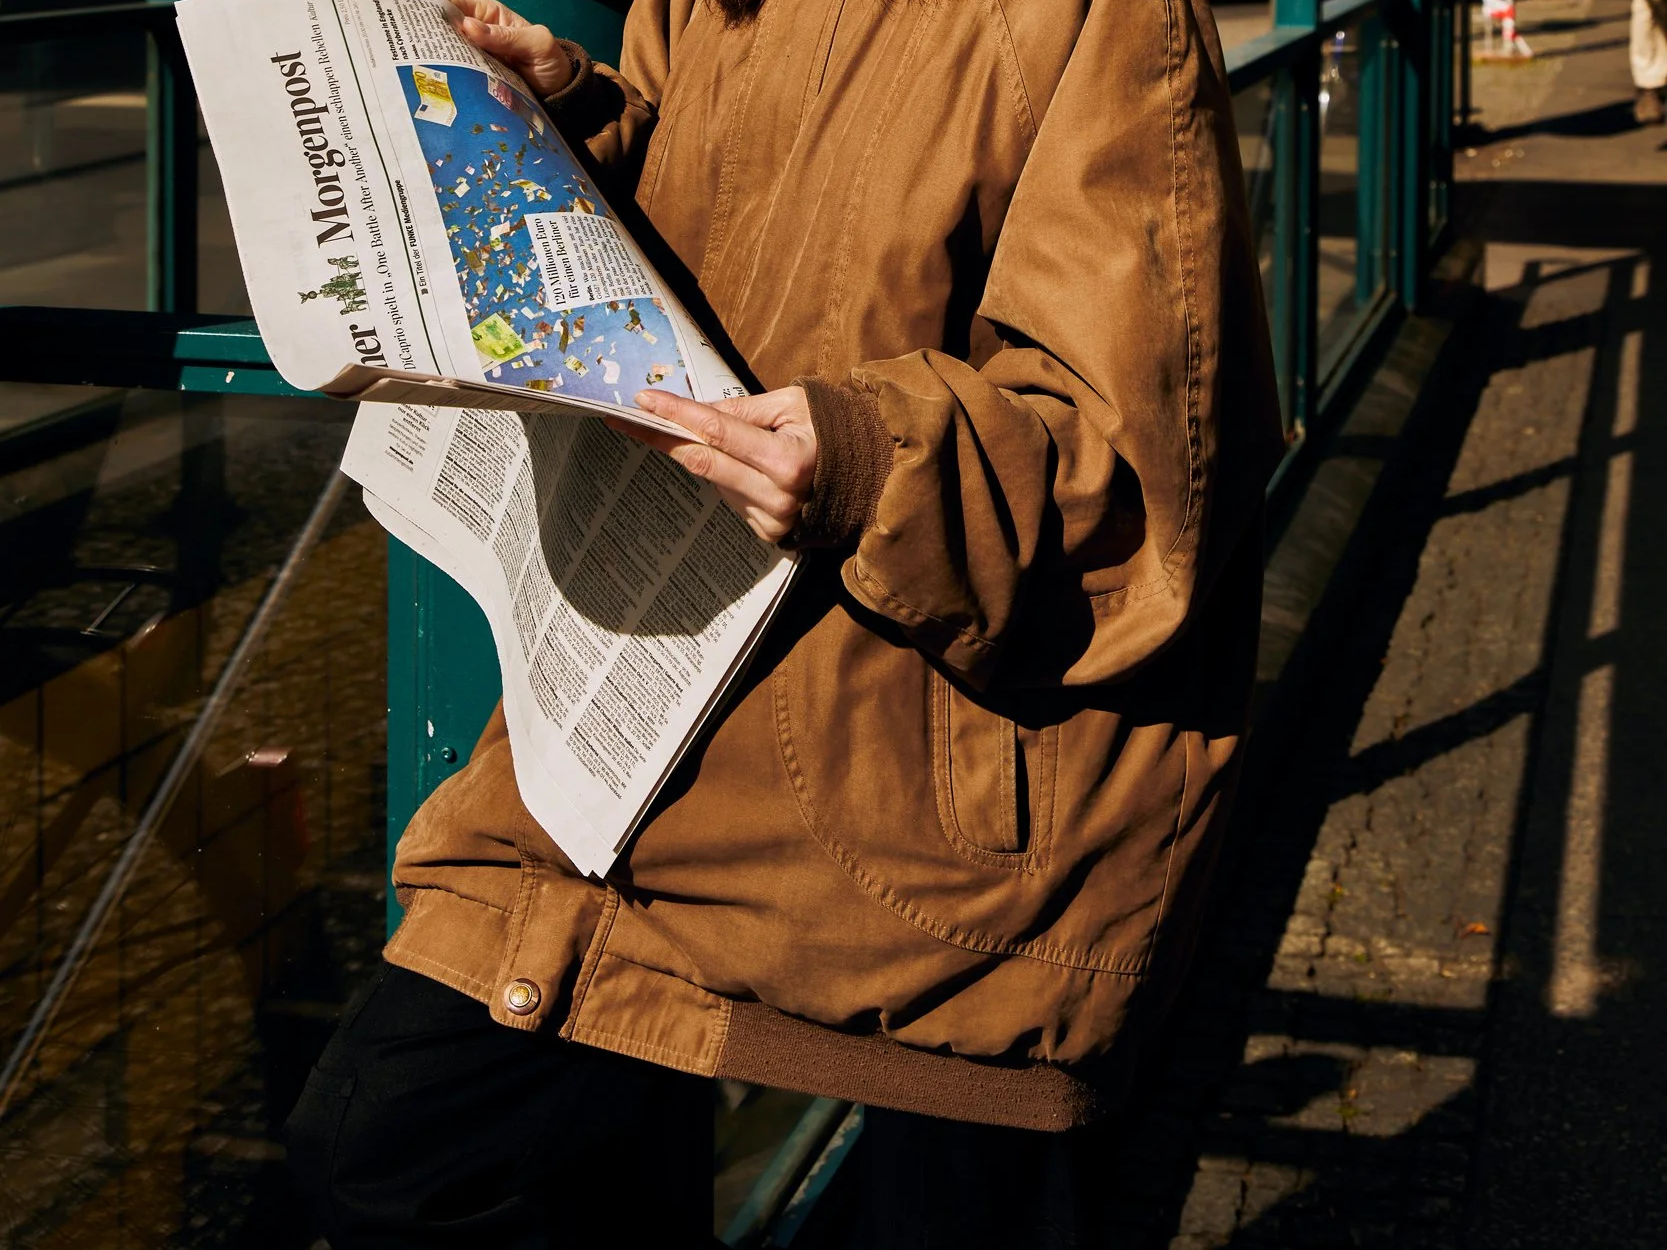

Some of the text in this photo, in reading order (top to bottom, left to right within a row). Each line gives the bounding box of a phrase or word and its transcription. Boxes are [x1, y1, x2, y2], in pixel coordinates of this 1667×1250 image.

[373, 0, 386, 22] England
[311, 24, 330, 64] Rebellen
[385, 29, 399, 60] Festnahme
[387, 9, 408, 59] nach Cyberattacke
[324, 67, 344, 113] schlappen
[338, 116, 353, 140] einen
[271, 50, 355, 249] Morgenpost
[344, 143, 367, 182] Another“
[360, 186, 375, 211] After
[395, 180, 411, 223] Mediengruppe
[366, 215, 383, 247] Battle
[406, 225, 417, 247] FUNKE
[377, 251, 391, 277] „One
[412, 249, 420, 259] der
[414, 260, 423, 275] Titel
[535, 218, 566, 305] 120 Millionen Euro
[549, 221, 580, 298] für einen Berliner
[382, 281, 393, 293] in
[384, 296, 402, 325] spielt
[394, 328, 416, 369] DiCaprio
[403, 417, 421, 432] entfernt
[406, 412, 418, 423] einen
[419, 421, 430, 431] Klick
[413, 409, 427, 421] Kultur
